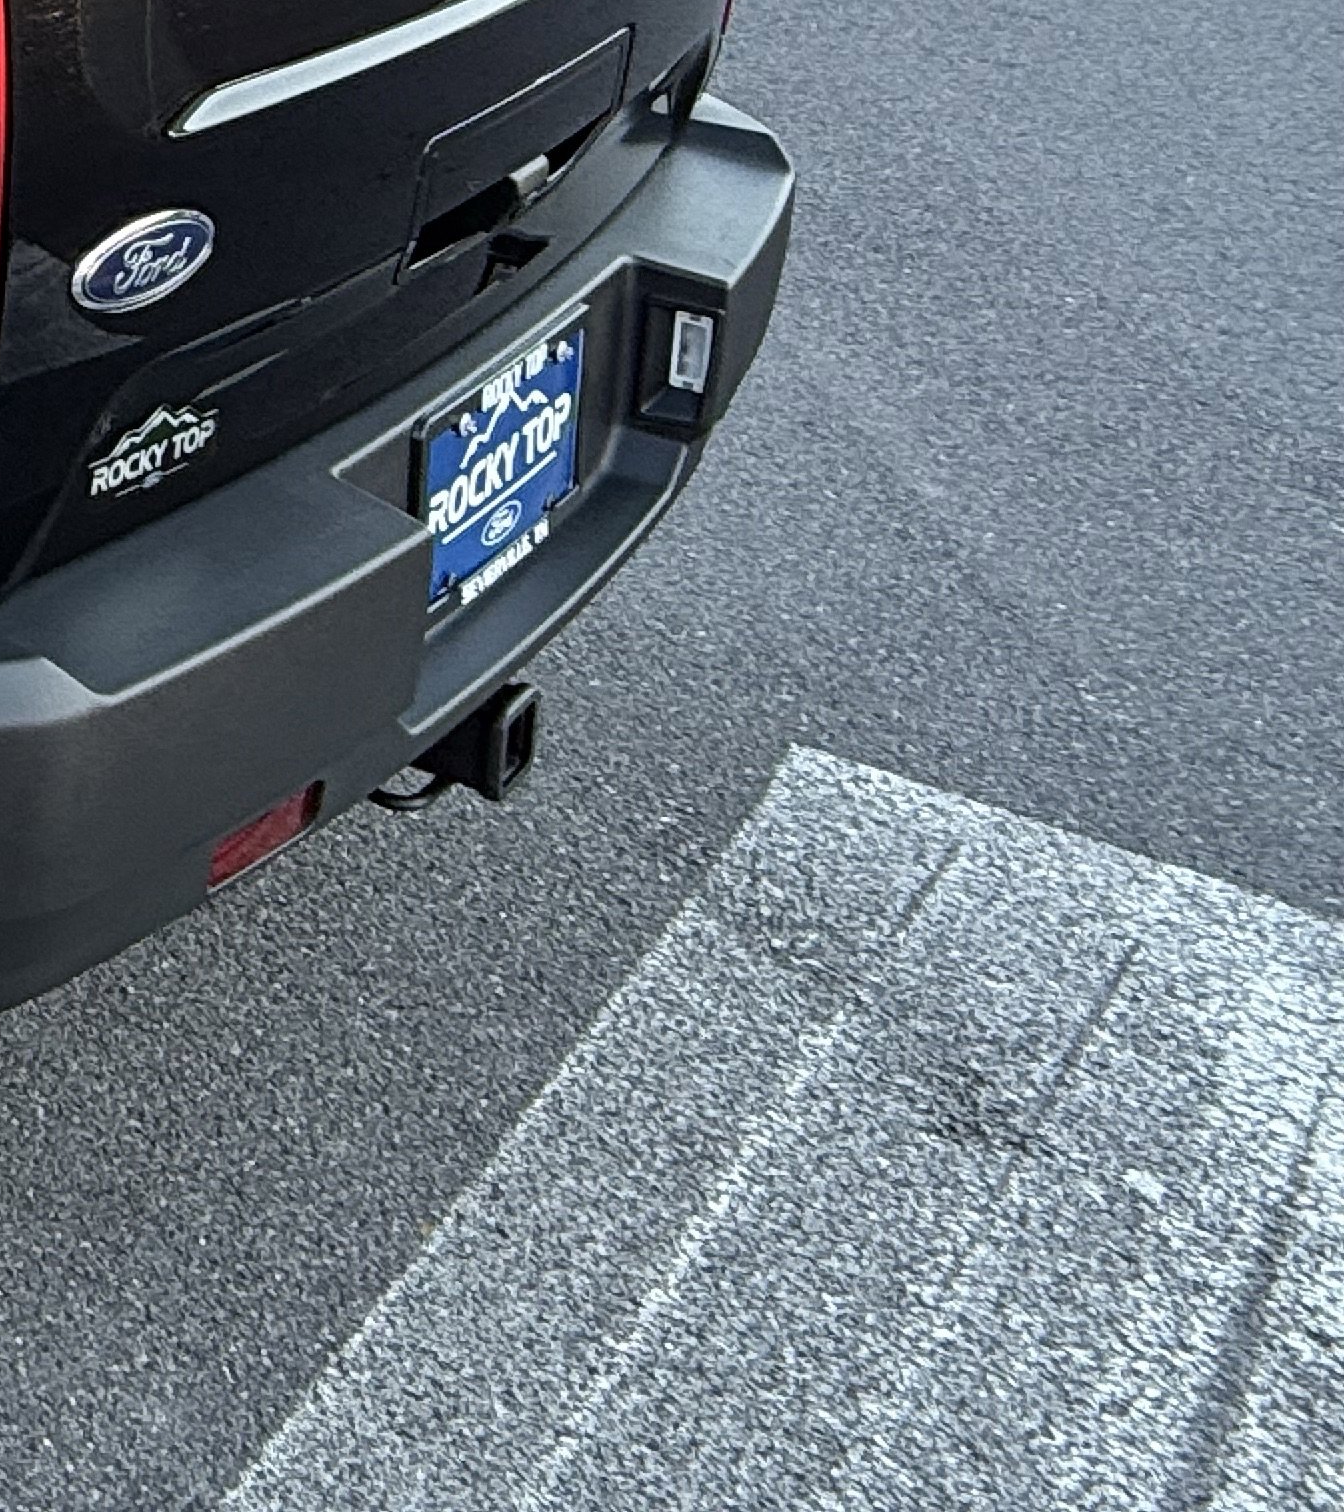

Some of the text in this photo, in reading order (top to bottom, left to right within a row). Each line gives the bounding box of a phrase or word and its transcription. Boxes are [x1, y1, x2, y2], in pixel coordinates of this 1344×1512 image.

[114, 232, 193, 295] Ford
[91, 418, 216, 496] ROCKY TOP
[428, 392, 572, 535] ROCKY TOP
